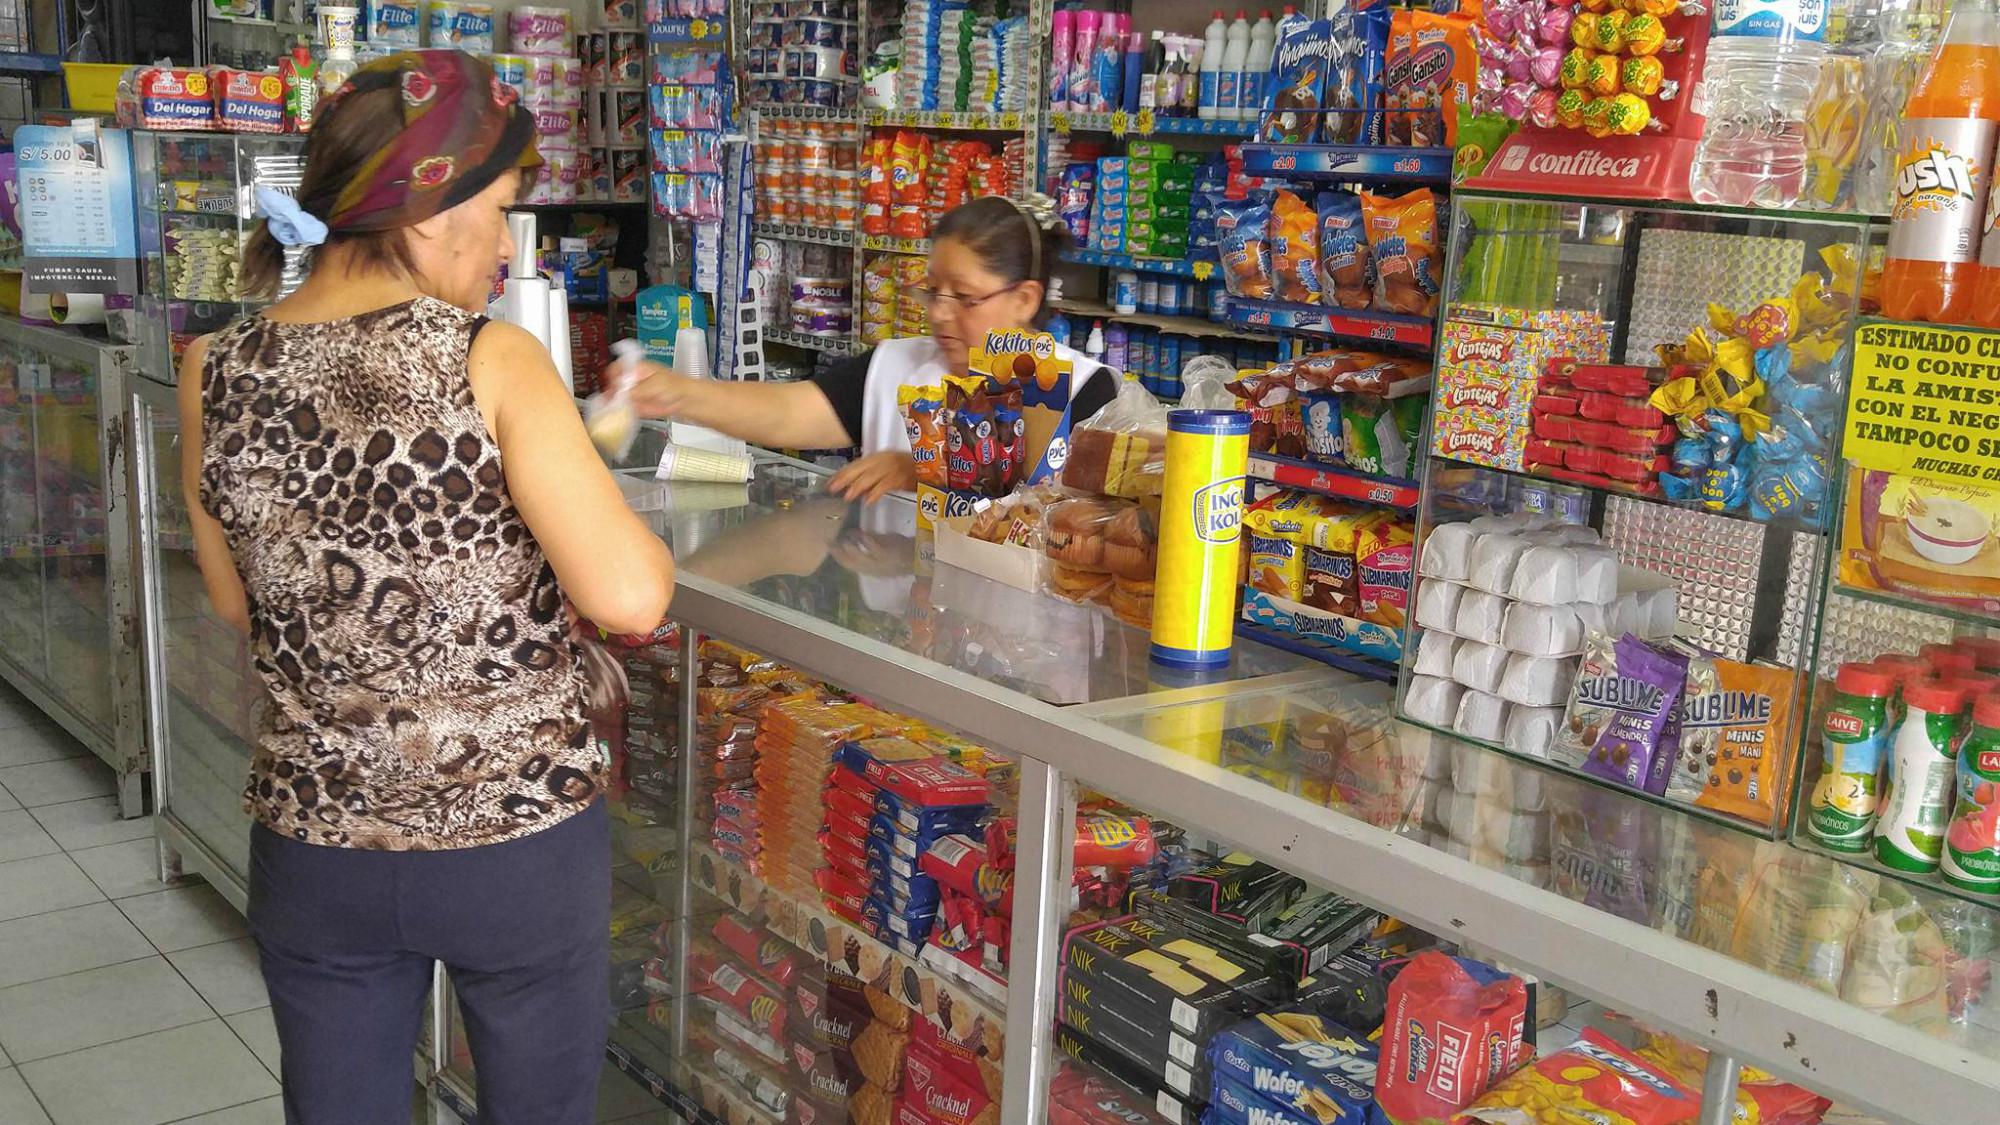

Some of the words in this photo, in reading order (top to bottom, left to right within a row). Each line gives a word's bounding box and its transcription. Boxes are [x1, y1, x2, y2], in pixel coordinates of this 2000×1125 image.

[381, 9, 413, 24] Elite
[456, 16, 488, 33] Elite
[531, 18, 566, 34] Elite
[652, 22, 685, 35] Downy
[1764, 20, 1781, 29] GAS
[1411, 51, 1447, 84] Gansito
[154, 101, 173, 113] Del
[176, 103, 211, 117] Hogar
[227, 102, 246, 115] Del
[249, 103, 281, 119] Hogar
[301, 78, 312, 122] SPORADE
[540, 114, 571, 130] Elite
[1529, 150, 1641, 178] confiteca
[641, 304, 668, 317] Pampers
[986, 332, 1032, 354] Kekitos
[1861, 327, 1971, 355] ESTIMADO
[1875, 353, 1909, 370] NO
[1917, 358, 2000, 381] CONFU
[1866, 376, 1905, 394] LA
[1855, 398, 1904, 418] CON
[1911, 405, 1941, 423] EL
[1948, 410, 2000, 430] NEG
[1855, 422, 1970, 453] TAMPOCO
[1912, 457, 1981, 478] MUCHAS
[1294, 612, 1345, 641] SUBMARINOS
[1578, 676, 1665, 712] SUBLIME
[1683, 692, 1772, 723] SUBLIME
[1609, 726, 1649, 744] ALMENDRA
[1827, 716, 1858, 731] LAIVE
[867, 764, 881, 777] FIELD
[1221, 880, 1243, 903] NIK
[1071, 945, 1096, 977] NIK
[1068, 977, 1092, 1009] NIK
[813, 1012, 852, 1039] Cracknel
[1067, 1005, 1090, 1034] NIK
[1061, 1034, 1083, 1063] NIK
[1224, 1050, 1250, 1072] Costa
[1436, 1034, 1460, 1092] FIELD
[811, 1069, 848, 1097] Cracknel
[1253, 1067, 1304, 1096] Wafer
[926, 1086, 971, 1116] Cracknel
[1221, 1089, 1245, 1112] Costa
